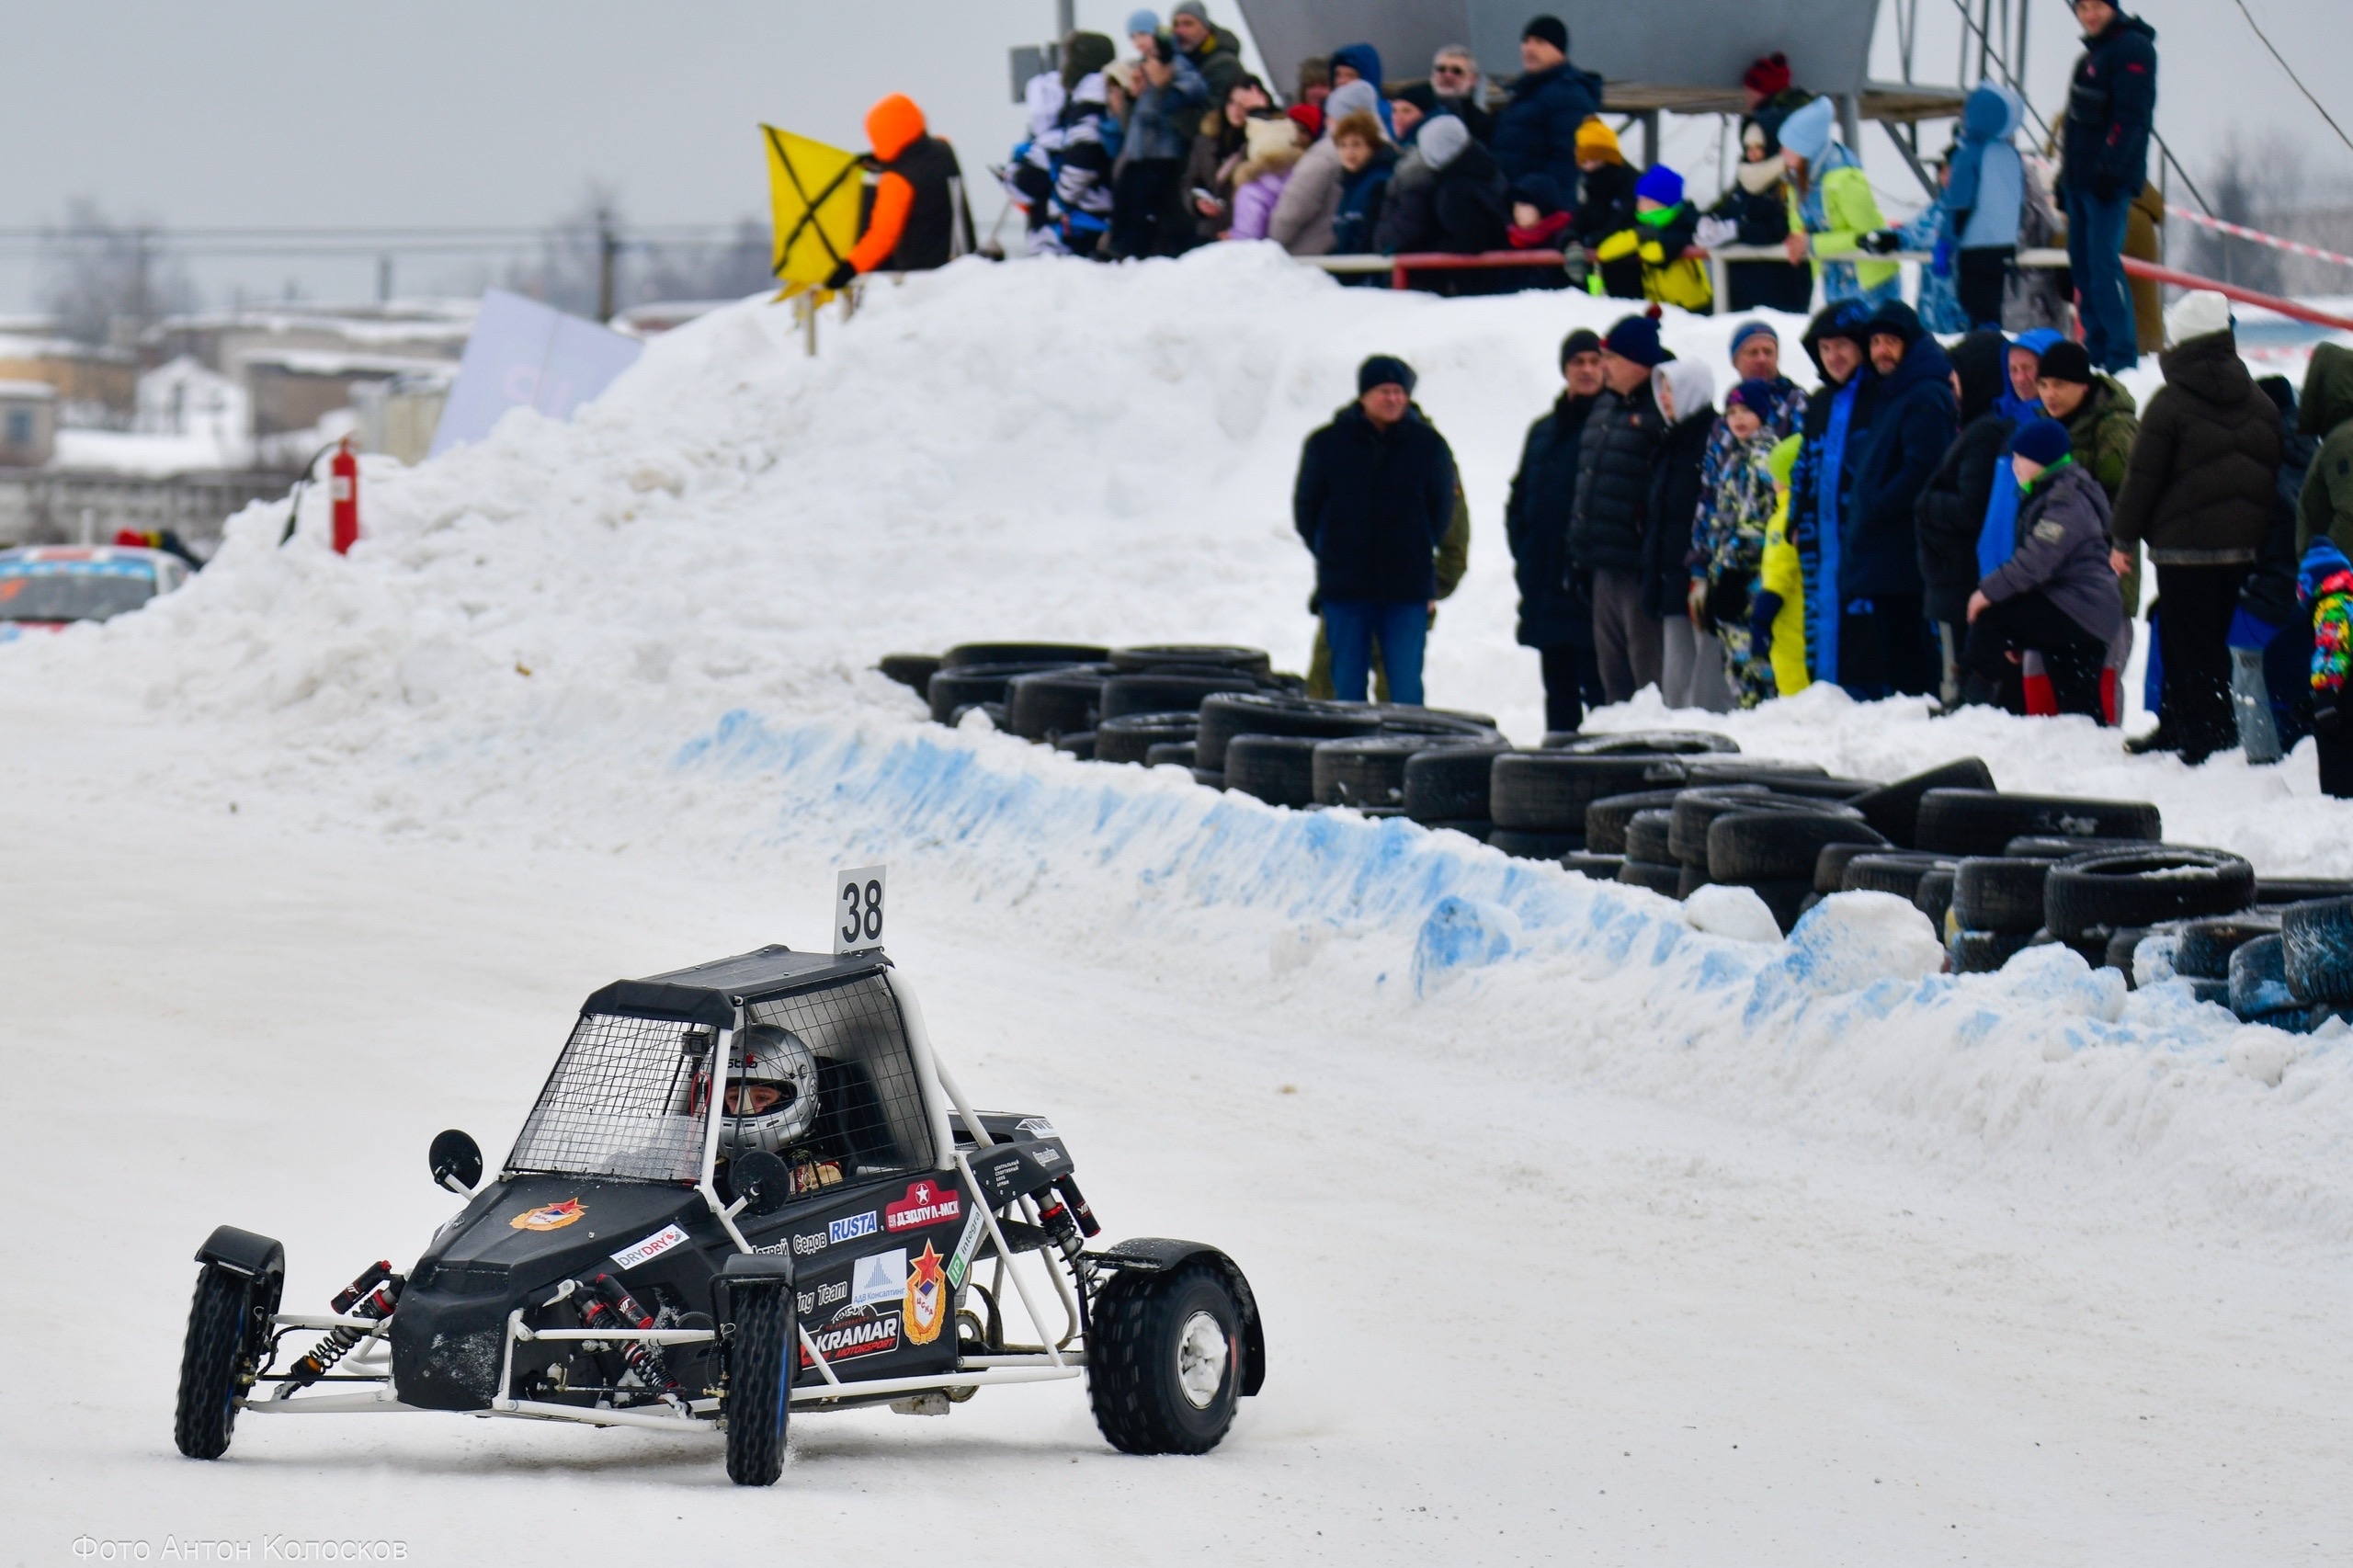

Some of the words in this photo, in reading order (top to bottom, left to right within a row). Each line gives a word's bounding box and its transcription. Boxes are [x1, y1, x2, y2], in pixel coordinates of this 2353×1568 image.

[842, 880, 882, 943] 38
[831, 1216, 876, 1242] RUSTA
[618, 1237, 668, 1266] DRYDRY
[793, 1233, 826, 1255] Седов
[951, 1260, 961, 1279] IP
[961, 1210, 981, 1256] integra
[797, 1291, 815, 1314] ing
[818, 1281, 847, 1306] Team
[853, 1294, 867, 1304] АДВ
[868, 1288, 905, 1300] Консалтинг
[916, 1297, 934, 1316] ЦСКА
[816, 1318, 897, 1352] KRAMAR
[835, 1338, 895, 1358] MOTORSPORT
